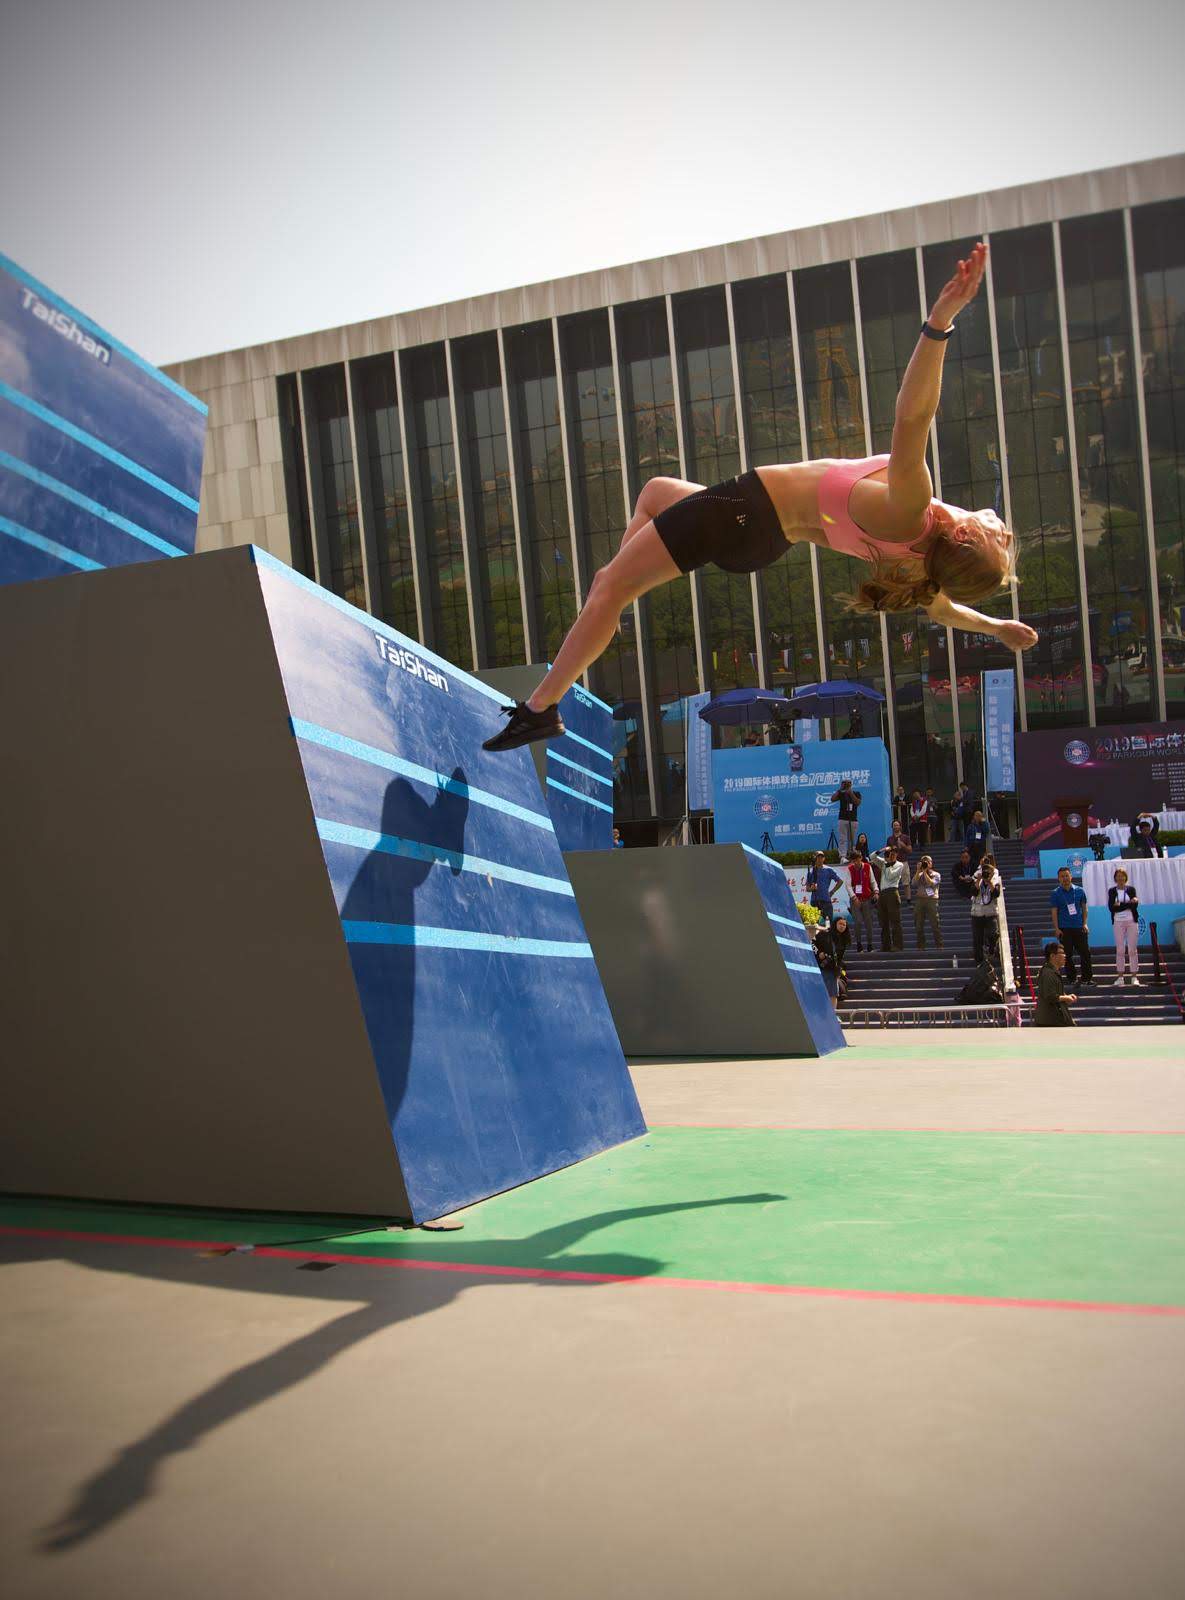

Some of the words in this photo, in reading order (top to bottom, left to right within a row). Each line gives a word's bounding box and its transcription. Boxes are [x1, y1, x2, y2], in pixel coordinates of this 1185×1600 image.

[22, 287, 111, 364] TaiShan
[375, 634, 449, 692] TaiShan
[1096, 732, 1185, 752] 2019国际体
[1112, 748, 1155, 759] PARKOUR
